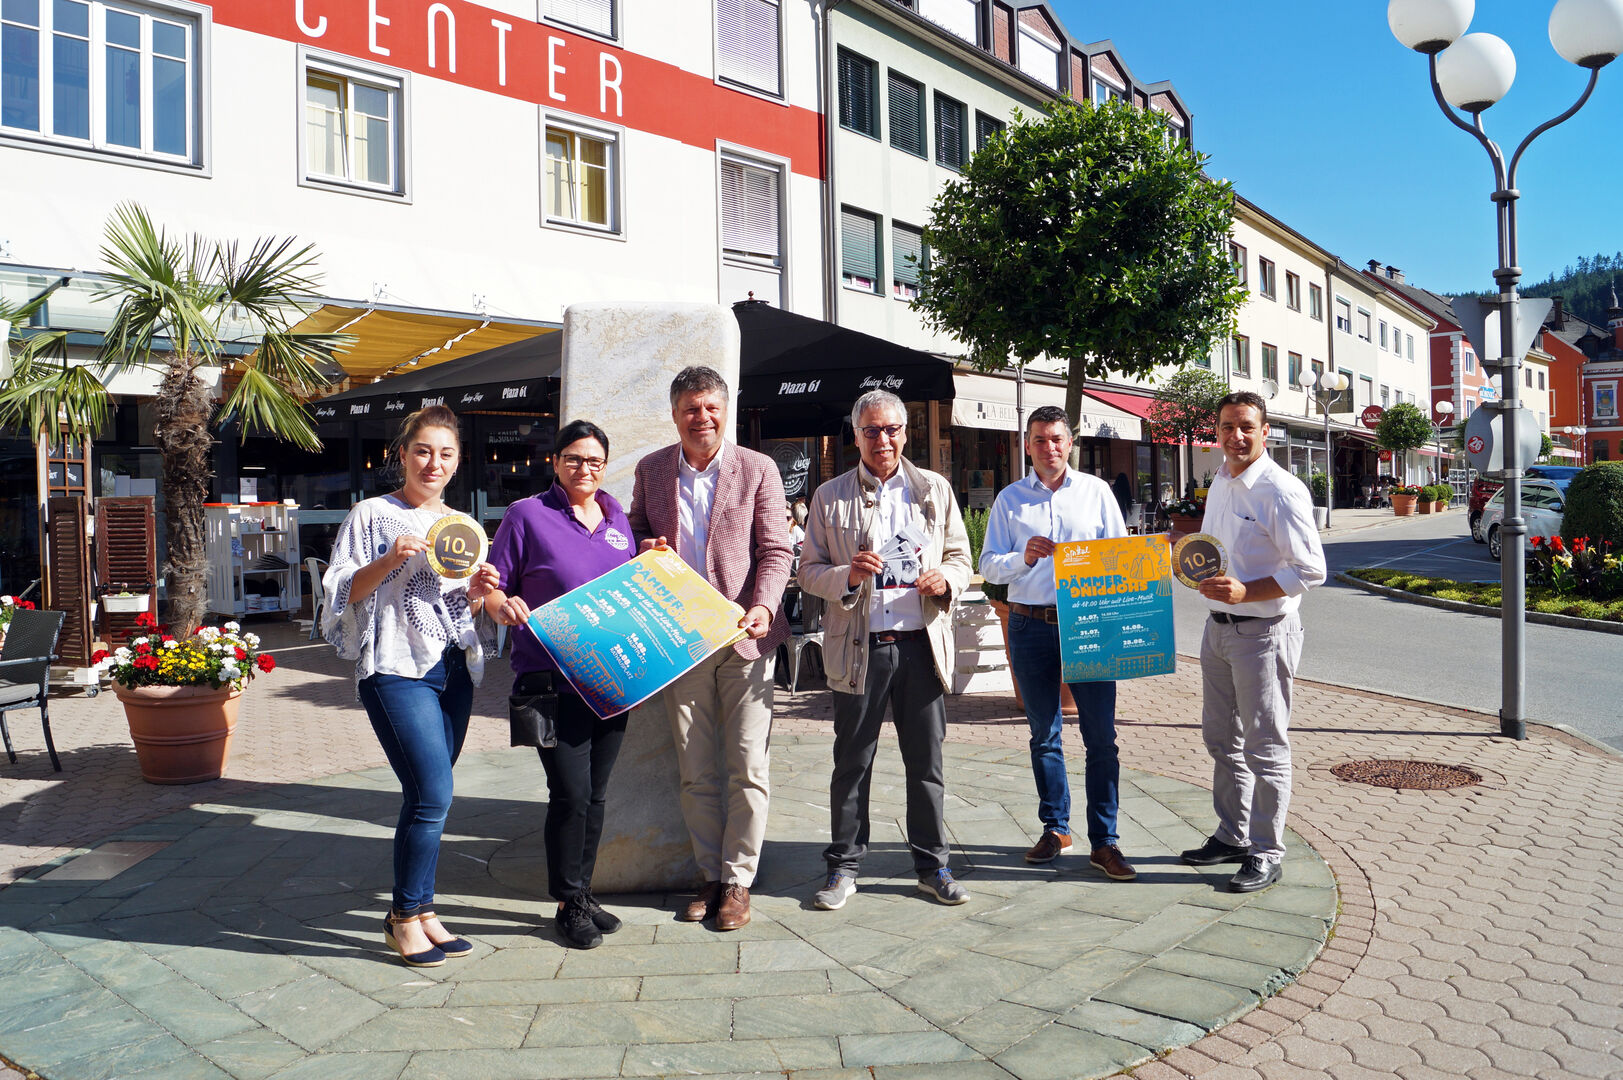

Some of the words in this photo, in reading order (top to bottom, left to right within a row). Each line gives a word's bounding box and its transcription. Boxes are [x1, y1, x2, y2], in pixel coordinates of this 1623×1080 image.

[778, 382, 806, 395] Plaza
[808, 379, 822, 392] 61
[860, 376, 882, 390] Juicy
[882, 374, 904, 390] Lucy
[502, 386, 520, 400] Plaza
[520, 385, 528, 398] 61
[350, 404, 364, 415] Plaza
[364, 403, 370, 414] 61
[421, 397, 436, 409] Plaza
[436, 396, 444, 407] 61
[1000, 407, 1017, 420] BELL
[1470, 436, 1484, 451] 26
[442, 536, 466, 554] 10
[1184, 552, 1205, 570] 10
[630, 560, 685, 611] DÄMMER-
[1059, 574, 1127, 590] DÄMMER-
[1070, 581, 1148, 598] SHOPPING
